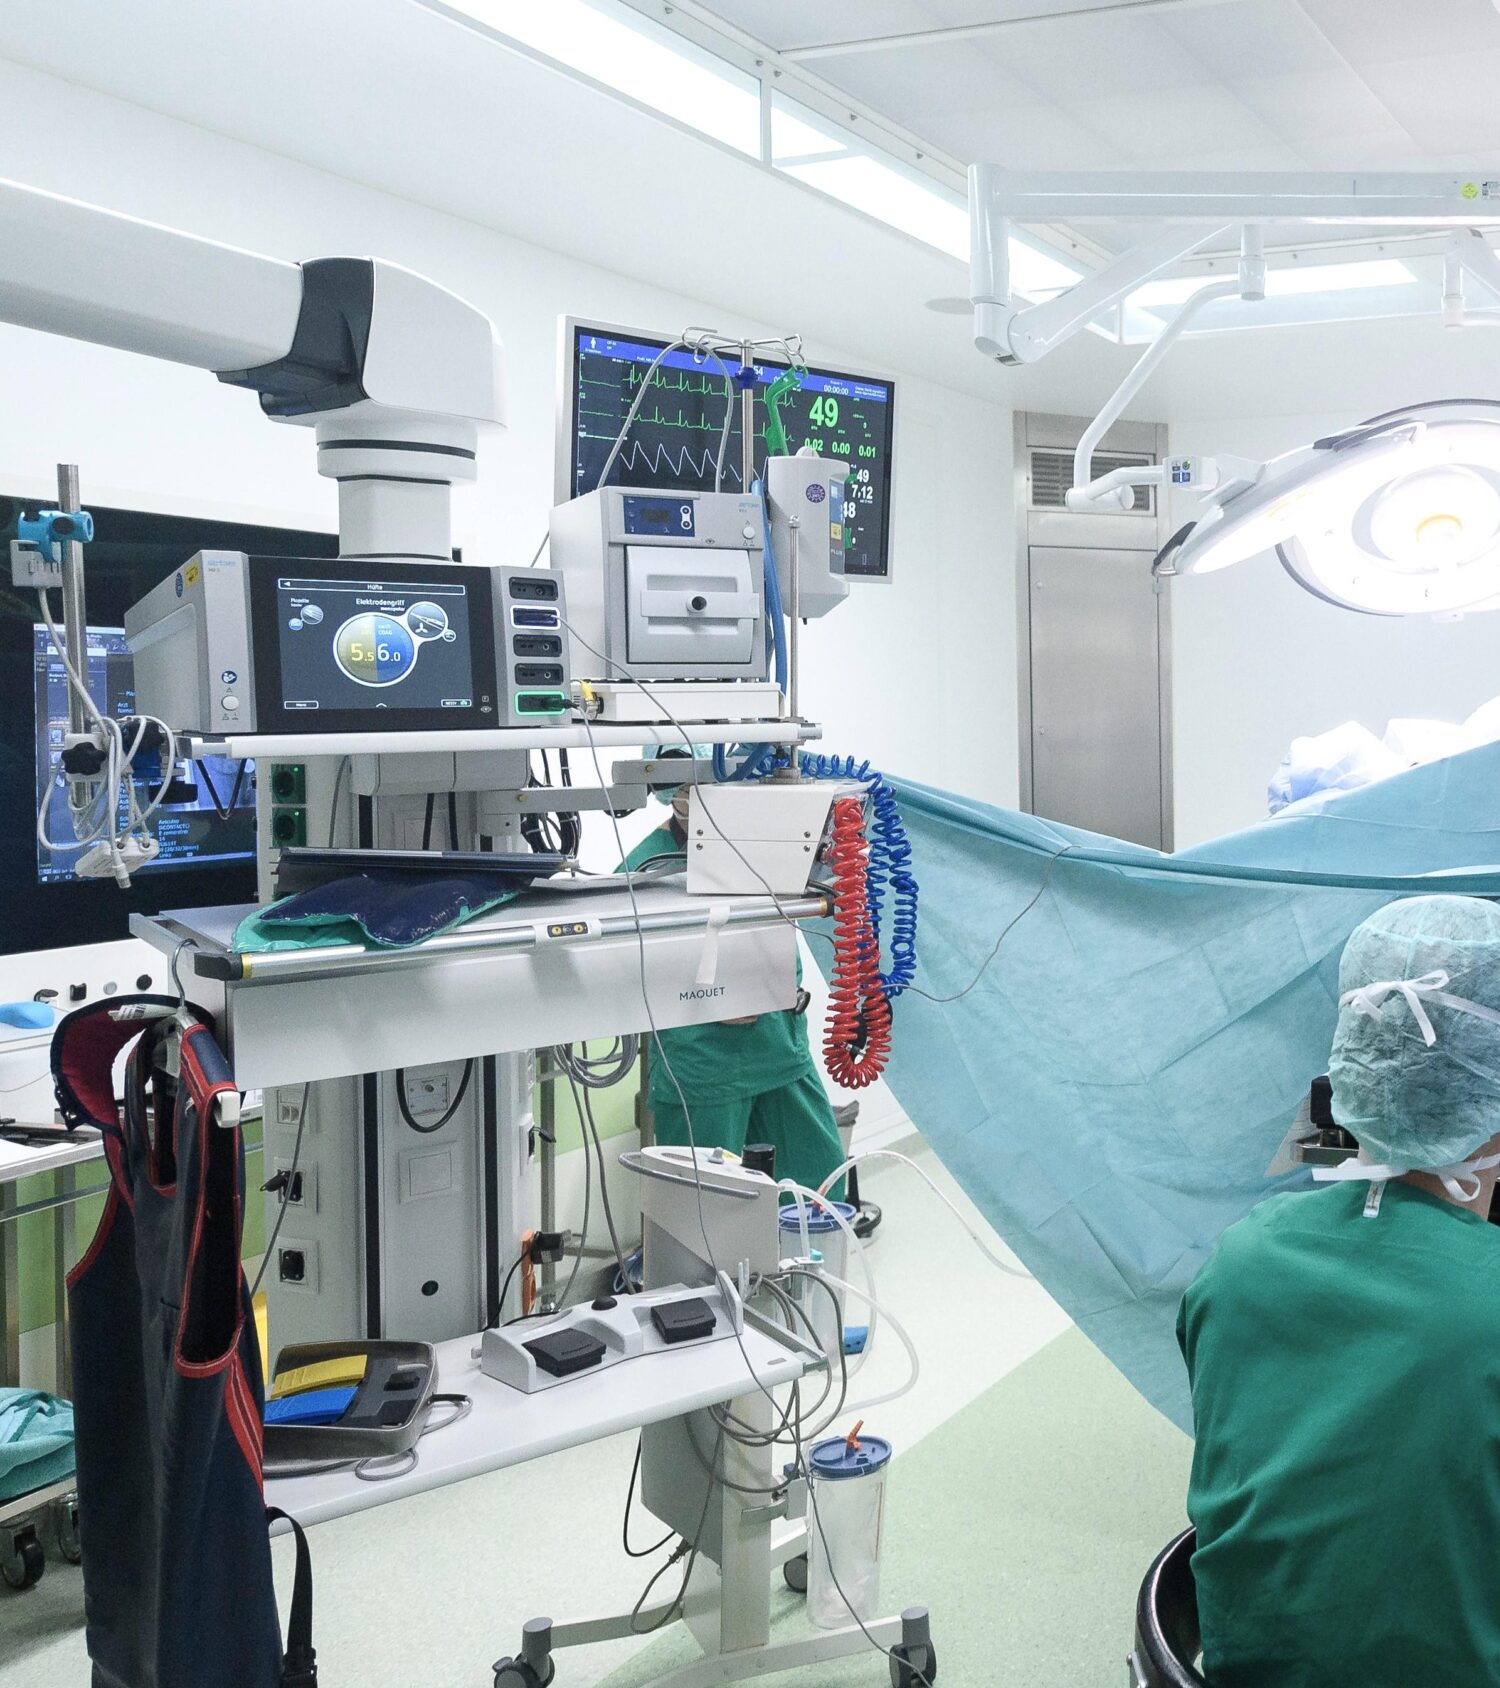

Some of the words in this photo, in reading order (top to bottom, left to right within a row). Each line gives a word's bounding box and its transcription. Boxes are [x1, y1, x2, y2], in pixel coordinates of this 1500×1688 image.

[809, 396, 839, 427] 49
[856, 468, 870, 483] 49
[355, 598, 405, 607] Elektrodengriff
[377, 643, 401, 662] 6.0
[679, 986, 726, 1001] MAQUET
